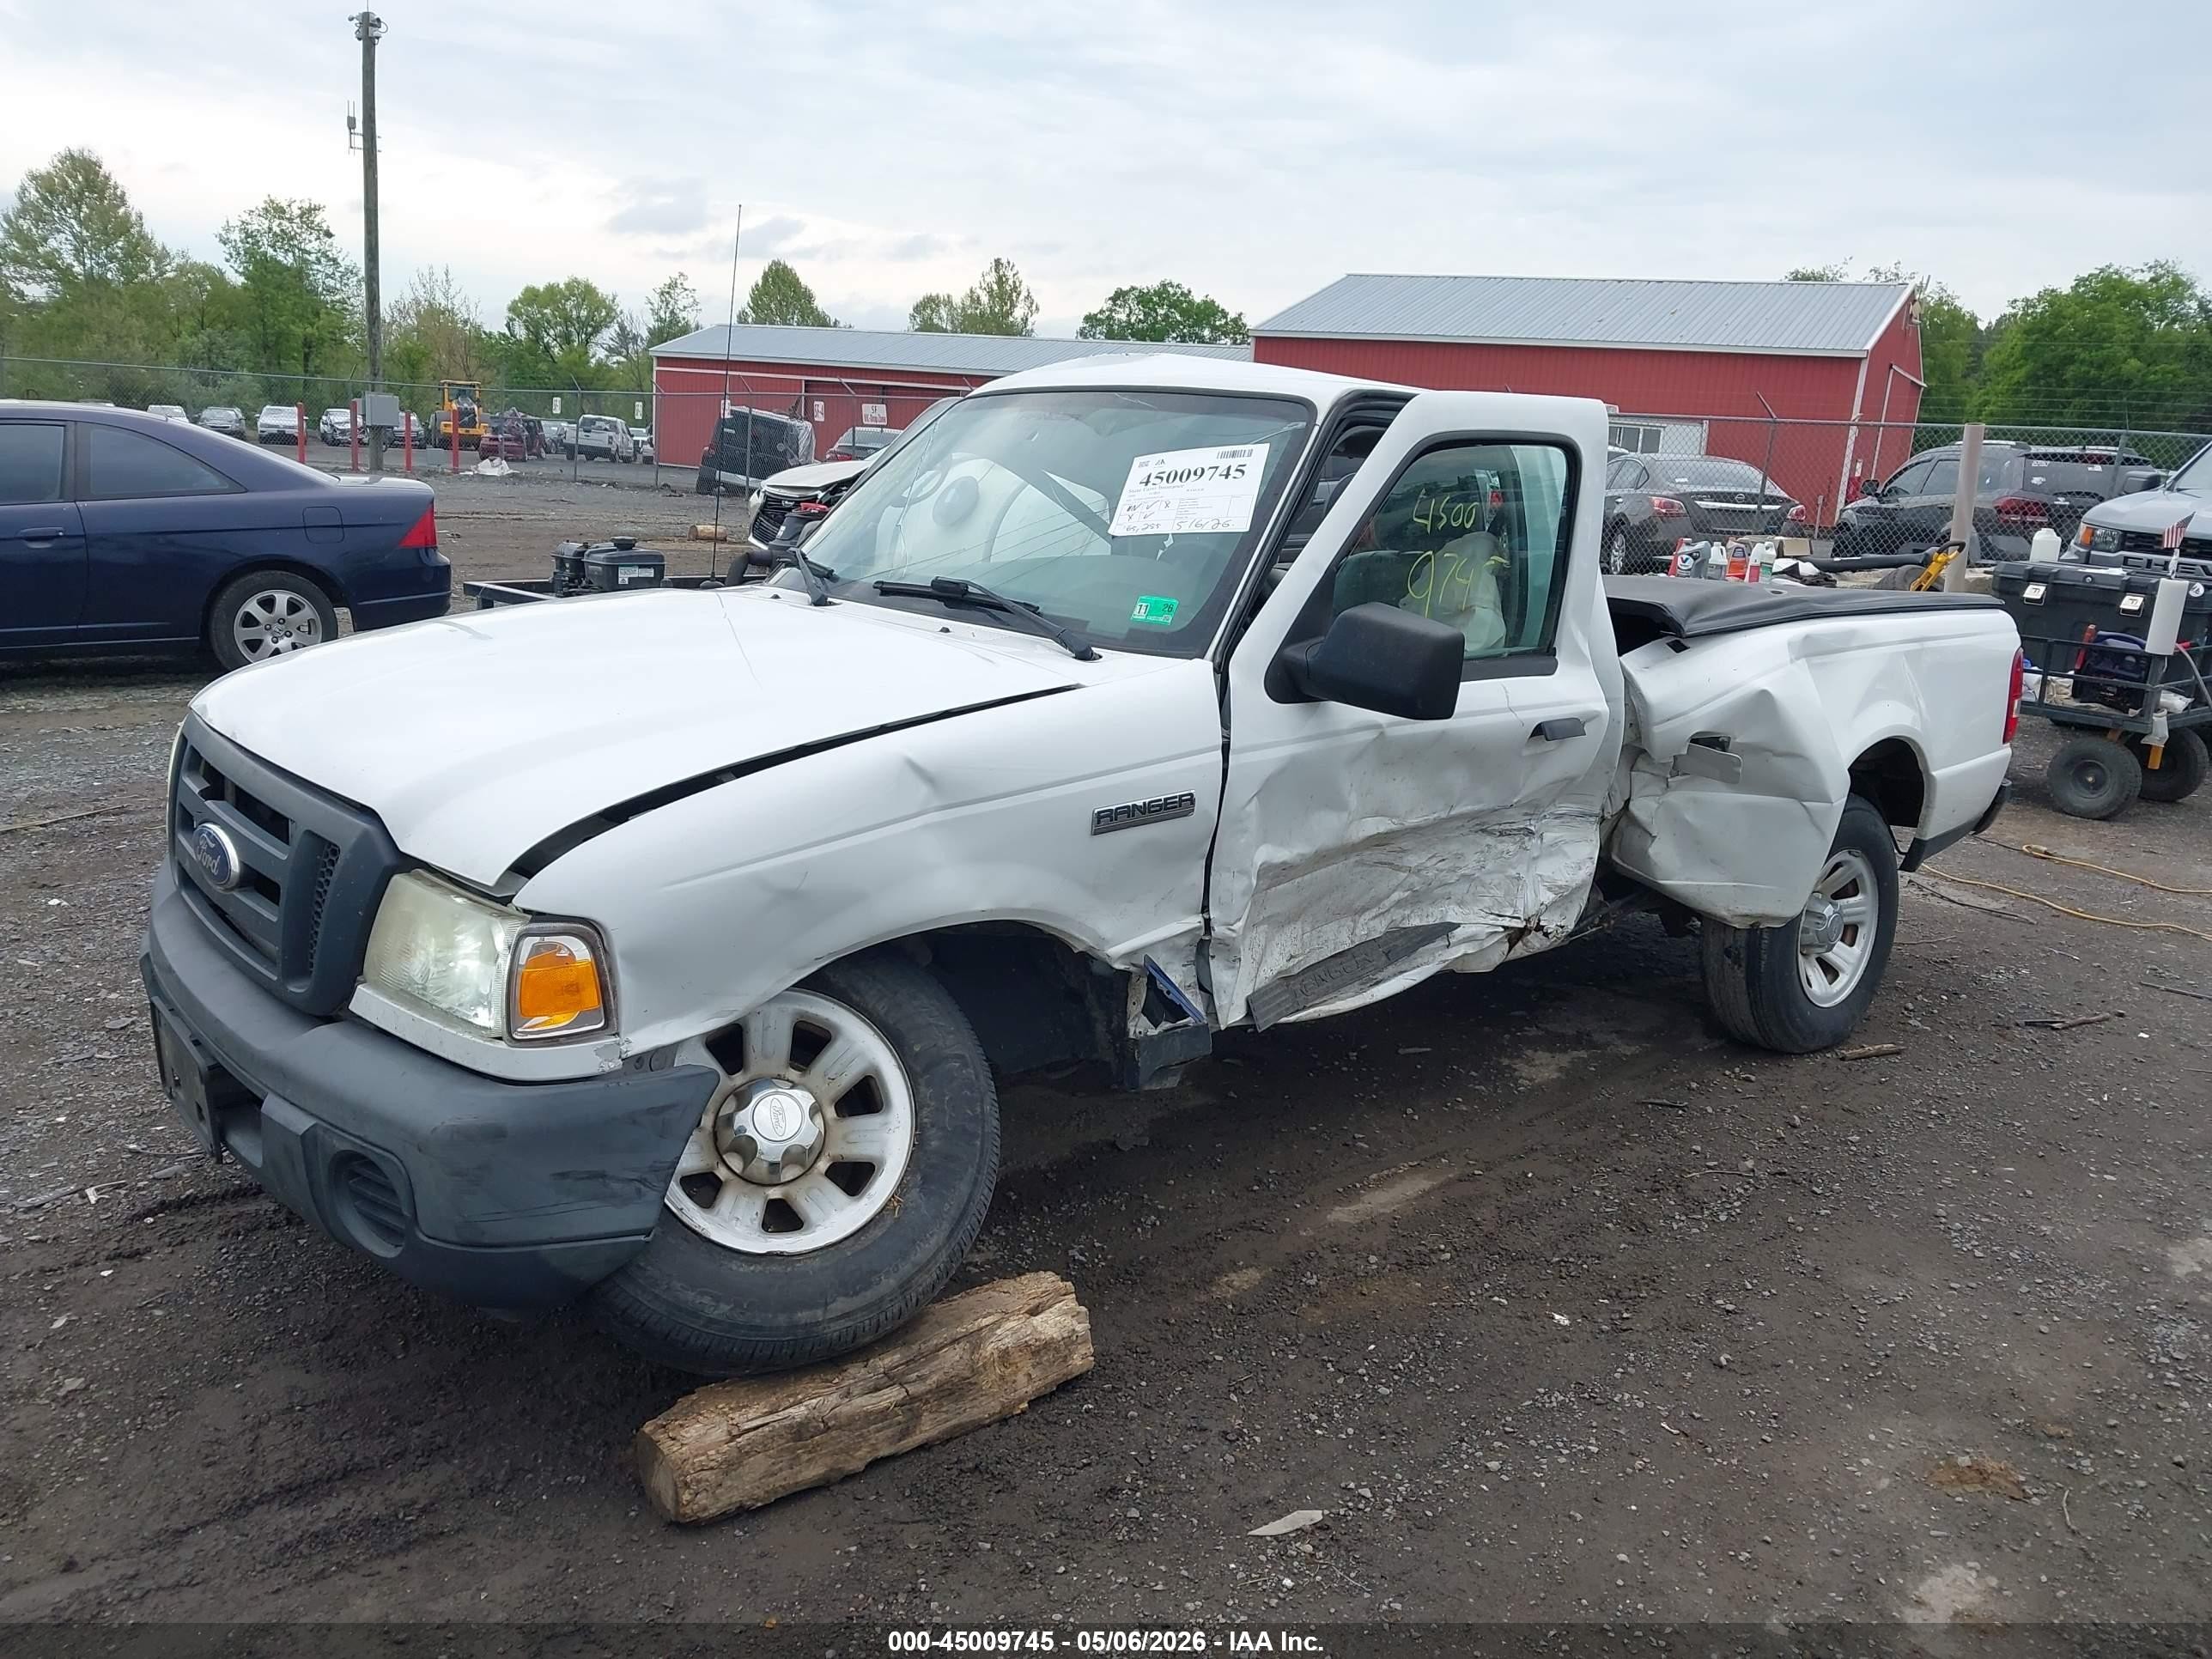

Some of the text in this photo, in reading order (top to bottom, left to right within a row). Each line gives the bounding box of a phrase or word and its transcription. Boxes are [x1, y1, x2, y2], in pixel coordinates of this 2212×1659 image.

[1139, 463, 1248, 487] 45009745
[1138, 603, 1174, 615] 11 26
[1096, 792, 1196, 825] RANGER
[196, 833, 221, 876] Ford
